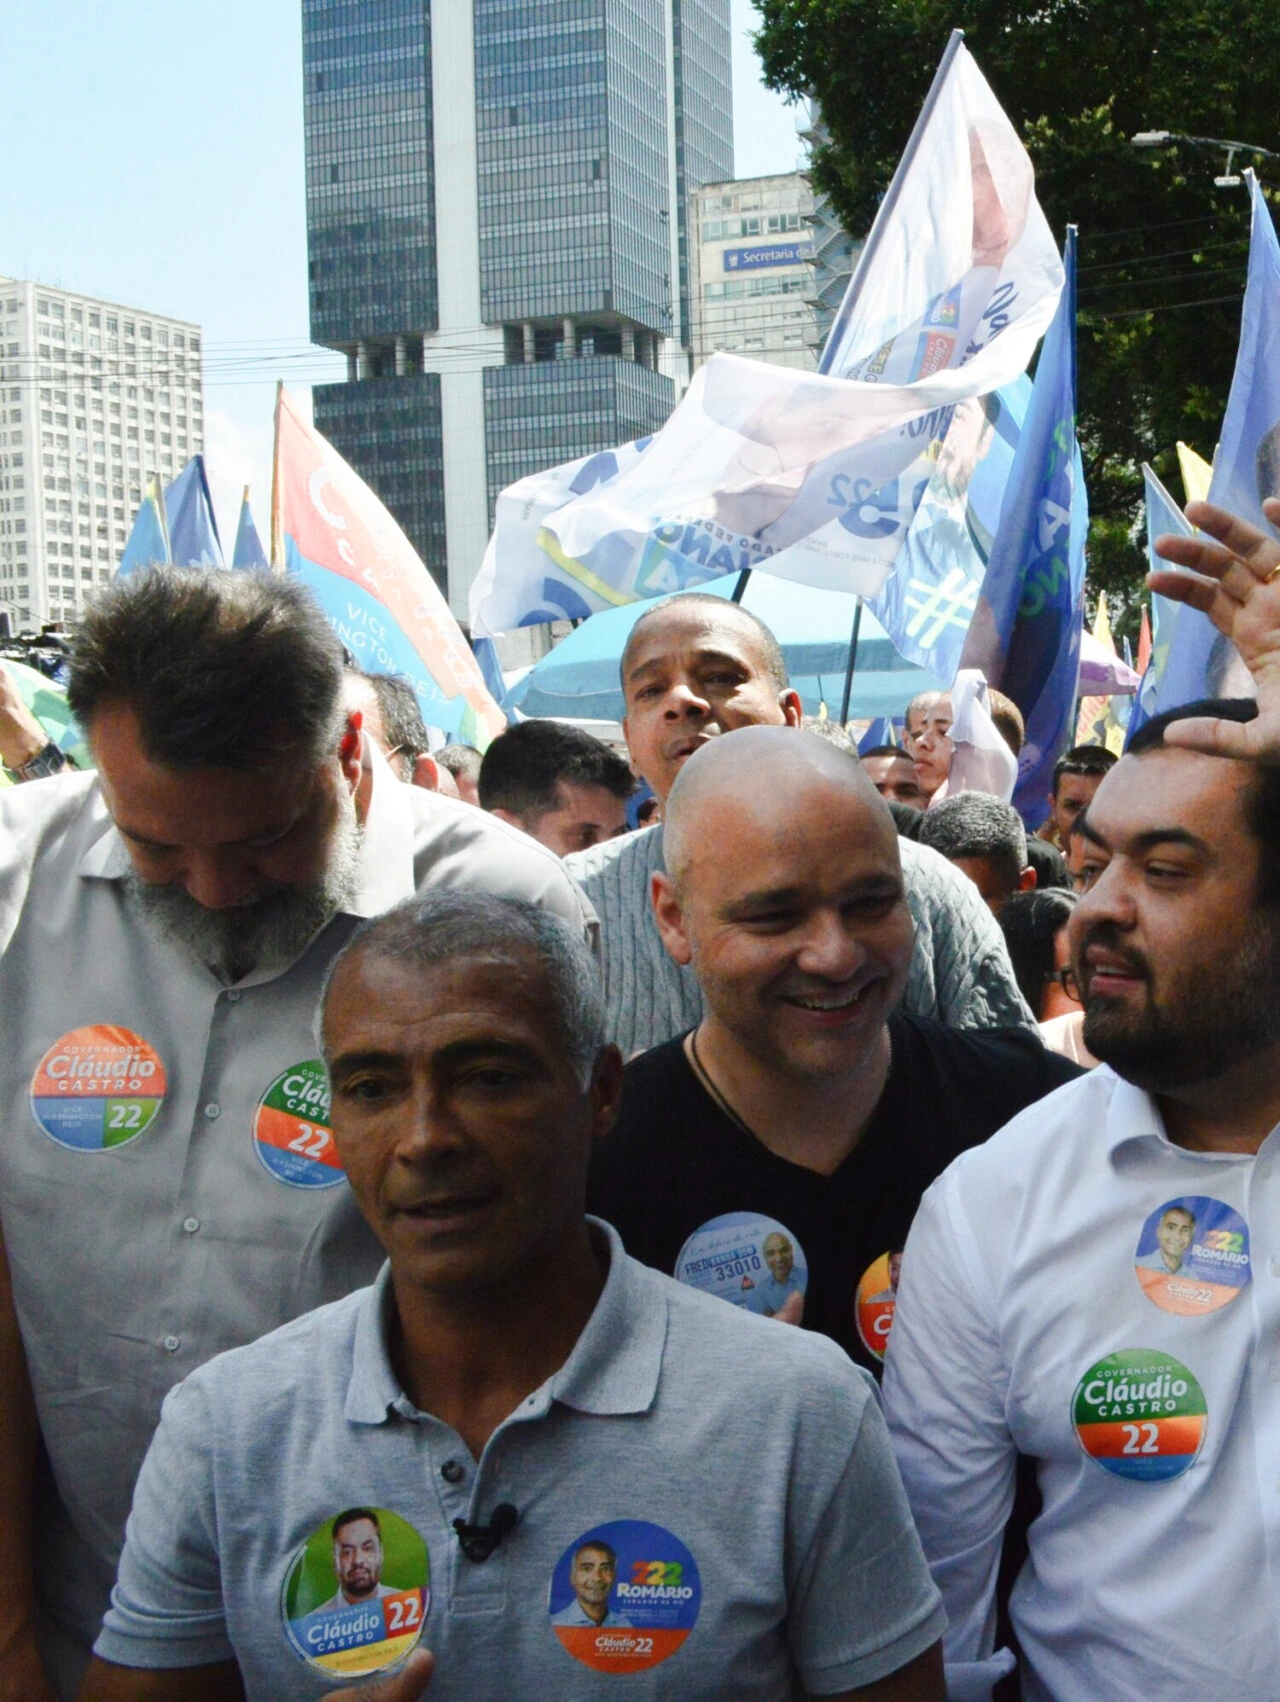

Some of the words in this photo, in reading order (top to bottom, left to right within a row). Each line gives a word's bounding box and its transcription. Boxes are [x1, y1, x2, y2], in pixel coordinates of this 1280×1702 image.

[743, 249, 794, 263] Secretaria
[347, 602, 388, 643] VICE
[402, 668, 457, 706] EIS
[63, 1045, 142, 1054] GOVERNADOR
[46, 1054, 156, 1079] Cláudio
[57, 1079, 142, 1091] CASTRO
[108, 1104, 142, 1128] 22
[288, 1124, 330, 1158] 22
[1205, 1229, 1245, 1252] 222
[1191, 1244, 1249, 1264] ROMÁRIO
[715, 1255, 761, 1281] 33010
[1196, 1289, 1212, 1302] 22
[1096, 1365, 1172, 1378] GOVERNADOR
[1084, 1374, 1188, 1405] Cláudio
[1098, 1399, 1177, 1416] CASTRO
[1122, 1423, 1159, 1454] 22
[632, 1560, 683, 1586] 222
[617, 1580, 693, 1599] ROMÁRIO
[389, 1597, 420, 1631] 22
[307, 1613, 380, 1644] Cláudio
[317, 1631, 374, 1651] CASTRO
[595, 1636, 636, 1648] Cláudio
[635, 1637, 653, 1653] 22
